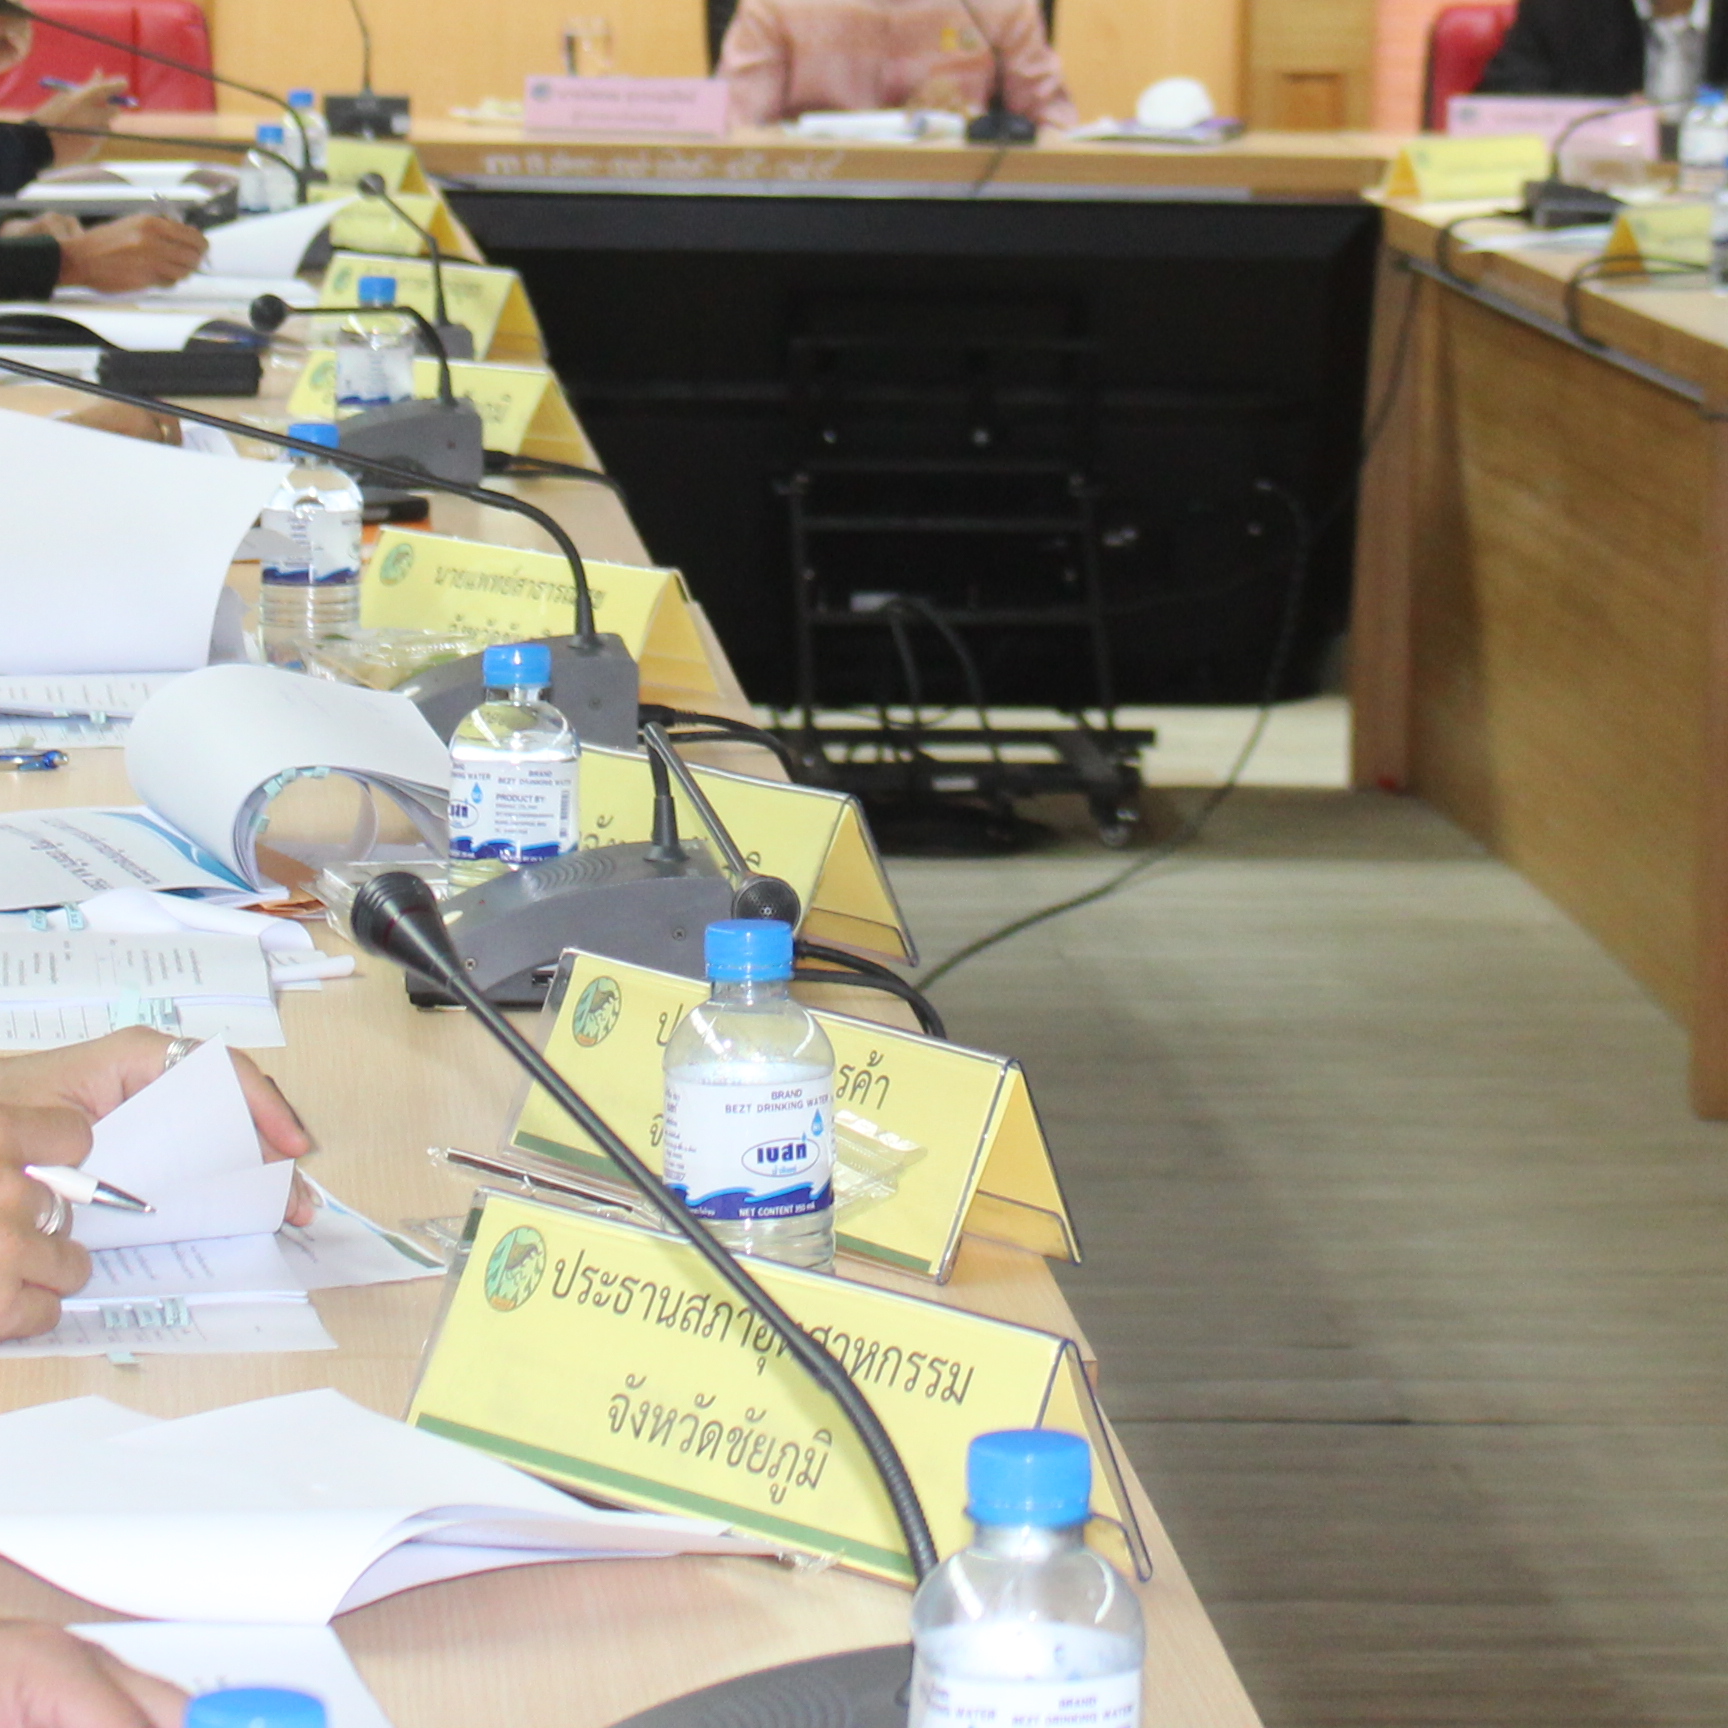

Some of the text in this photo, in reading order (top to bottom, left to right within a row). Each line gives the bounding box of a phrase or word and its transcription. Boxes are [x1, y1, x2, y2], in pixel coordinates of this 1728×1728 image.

[771, 1088, 803, 1101] BRAND
[725, 1094, 829, 1114] BEZT DRINKING WATER
[739, 1207, 756, 1217] NET
[607, 1373, 834, 1505] จังหวัดชัยภูมิ
